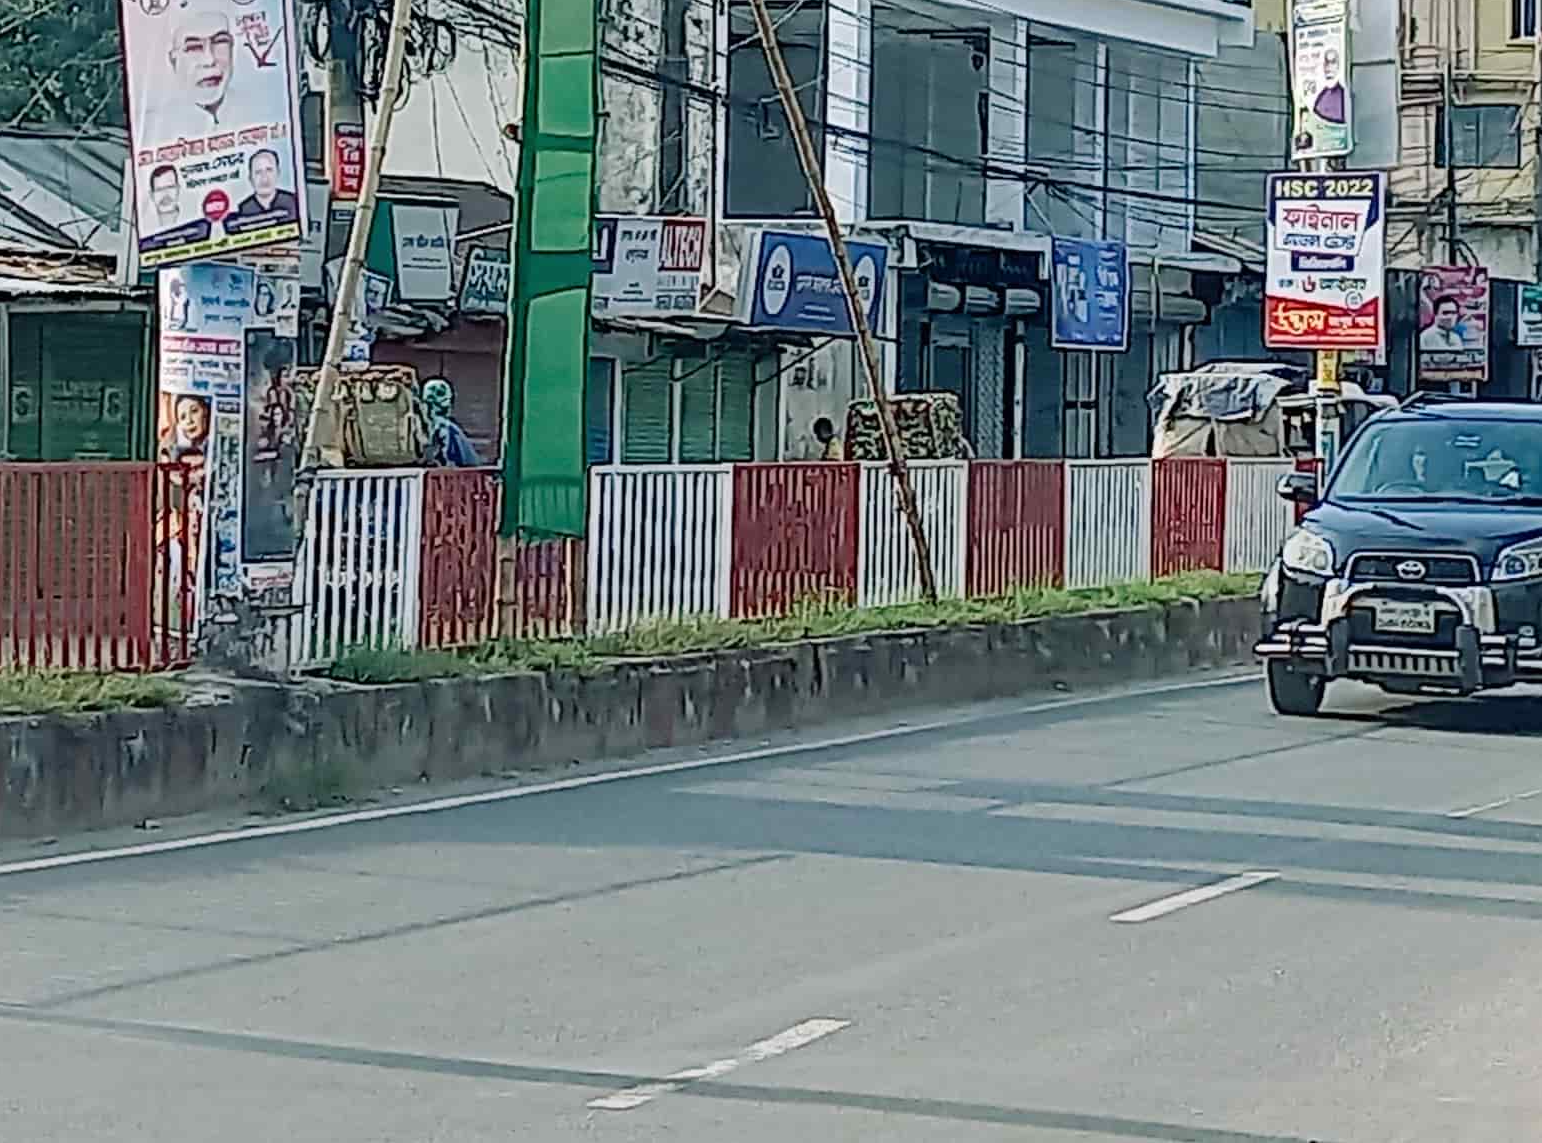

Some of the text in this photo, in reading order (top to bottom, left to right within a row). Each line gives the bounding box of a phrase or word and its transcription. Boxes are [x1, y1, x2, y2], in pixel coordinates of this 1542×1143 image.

[1275, 178, 1374, 198] HSC 2022
[1282, 203, 1363, 233] ফাইনাল
